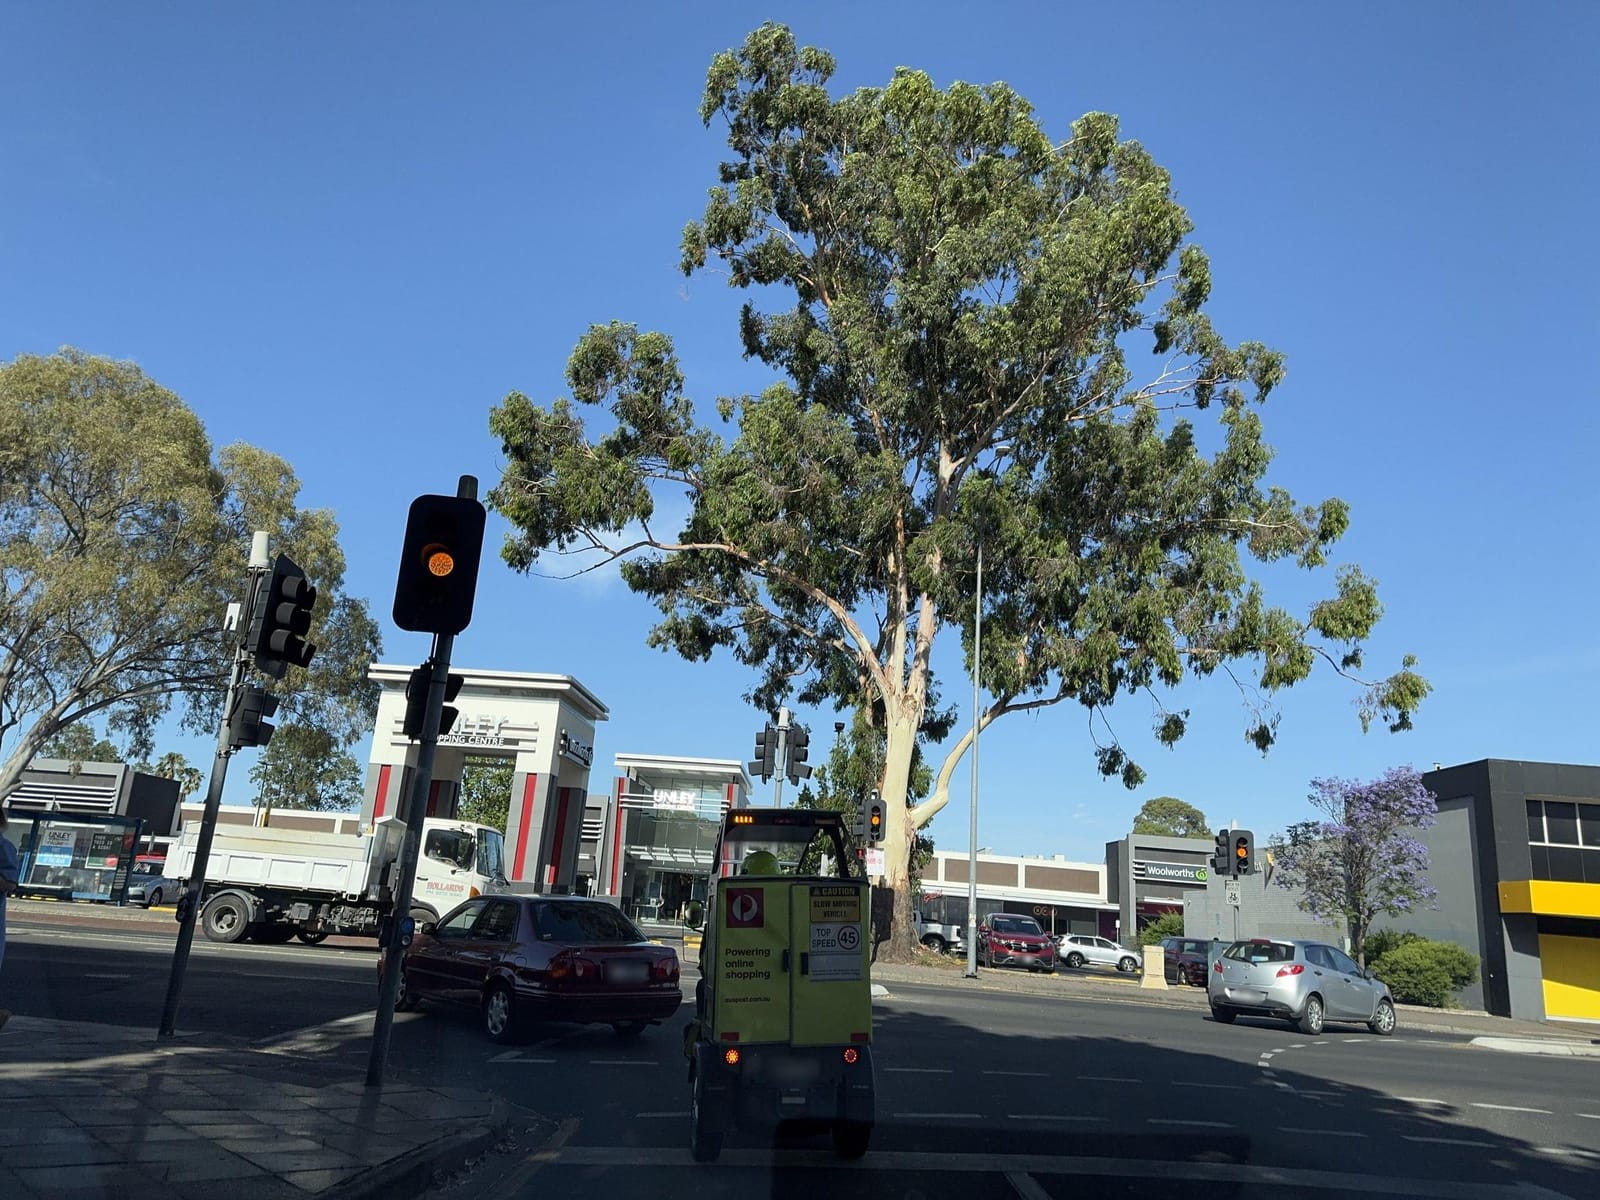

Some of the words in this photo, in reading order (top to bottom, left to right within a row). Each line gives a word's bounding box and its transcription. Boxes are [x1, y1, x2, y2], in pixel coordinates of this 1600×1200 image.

[436, 734, 466, 744] PPING
[468, 736, 505, 746] CENTRE
[653, 789, 696, 804] UNLEY
[1147, 865, 1195, 878] Woolworths
[822, 887, 855, 896] CAUTION
[816, 928, 832, 937] TOP
[812, 939, 837, 948] SPEED
[840, 931, 856, 945] 45
[725, 947, 771, 958] Powering
[725, 959, 755, 969] online
[725, 970, 771, 980] shopping
